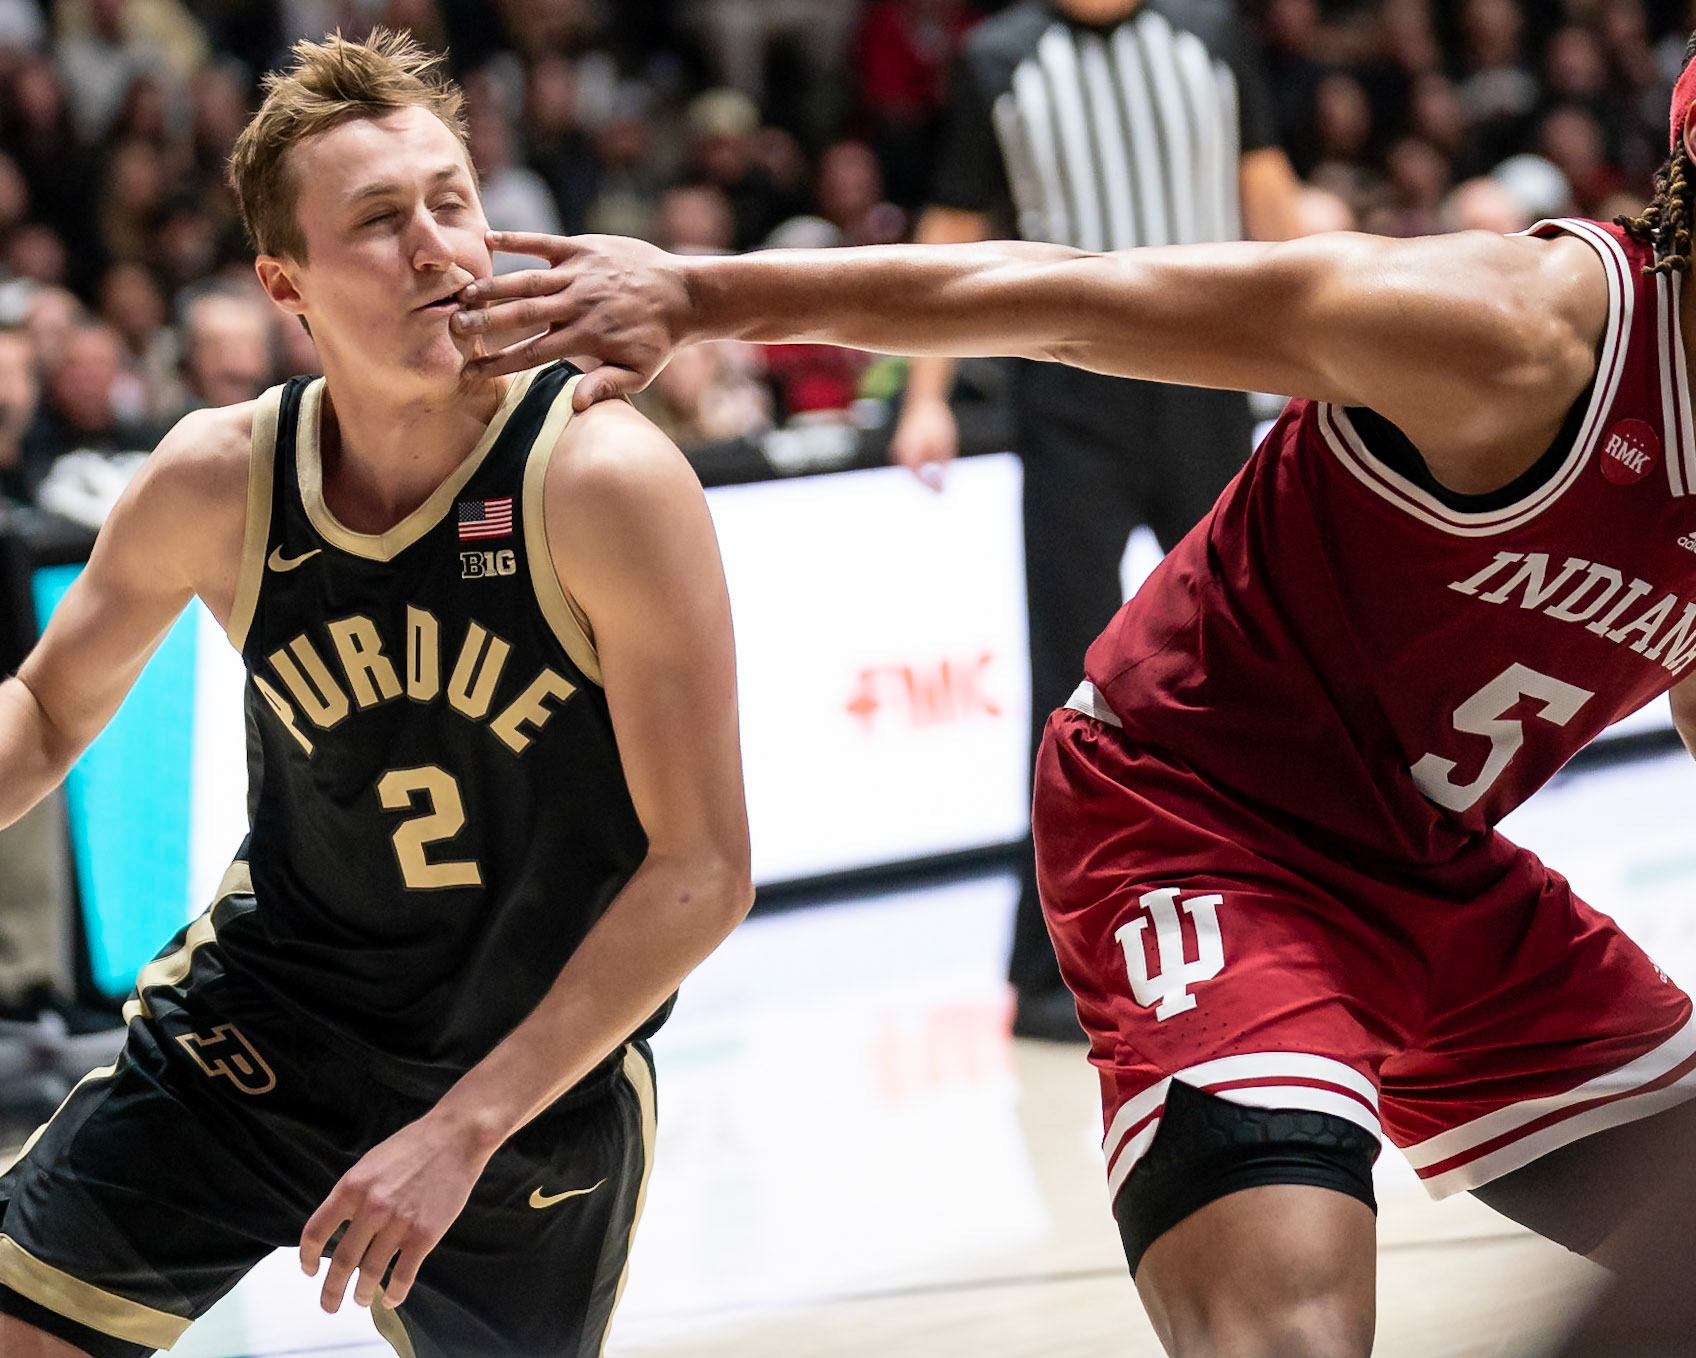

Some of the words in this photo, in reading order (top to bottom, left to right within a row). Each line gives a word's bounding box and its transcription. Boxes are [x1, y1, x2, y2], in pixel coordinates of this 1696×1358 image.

[1605, 433, 1651, 474] RMK
[251, 603, 579, 758] PURDUE
[1410, 662, 1595, 813] 5
[376, 764, 485, 889] 2
[175, 1022, 277, 1095] P
